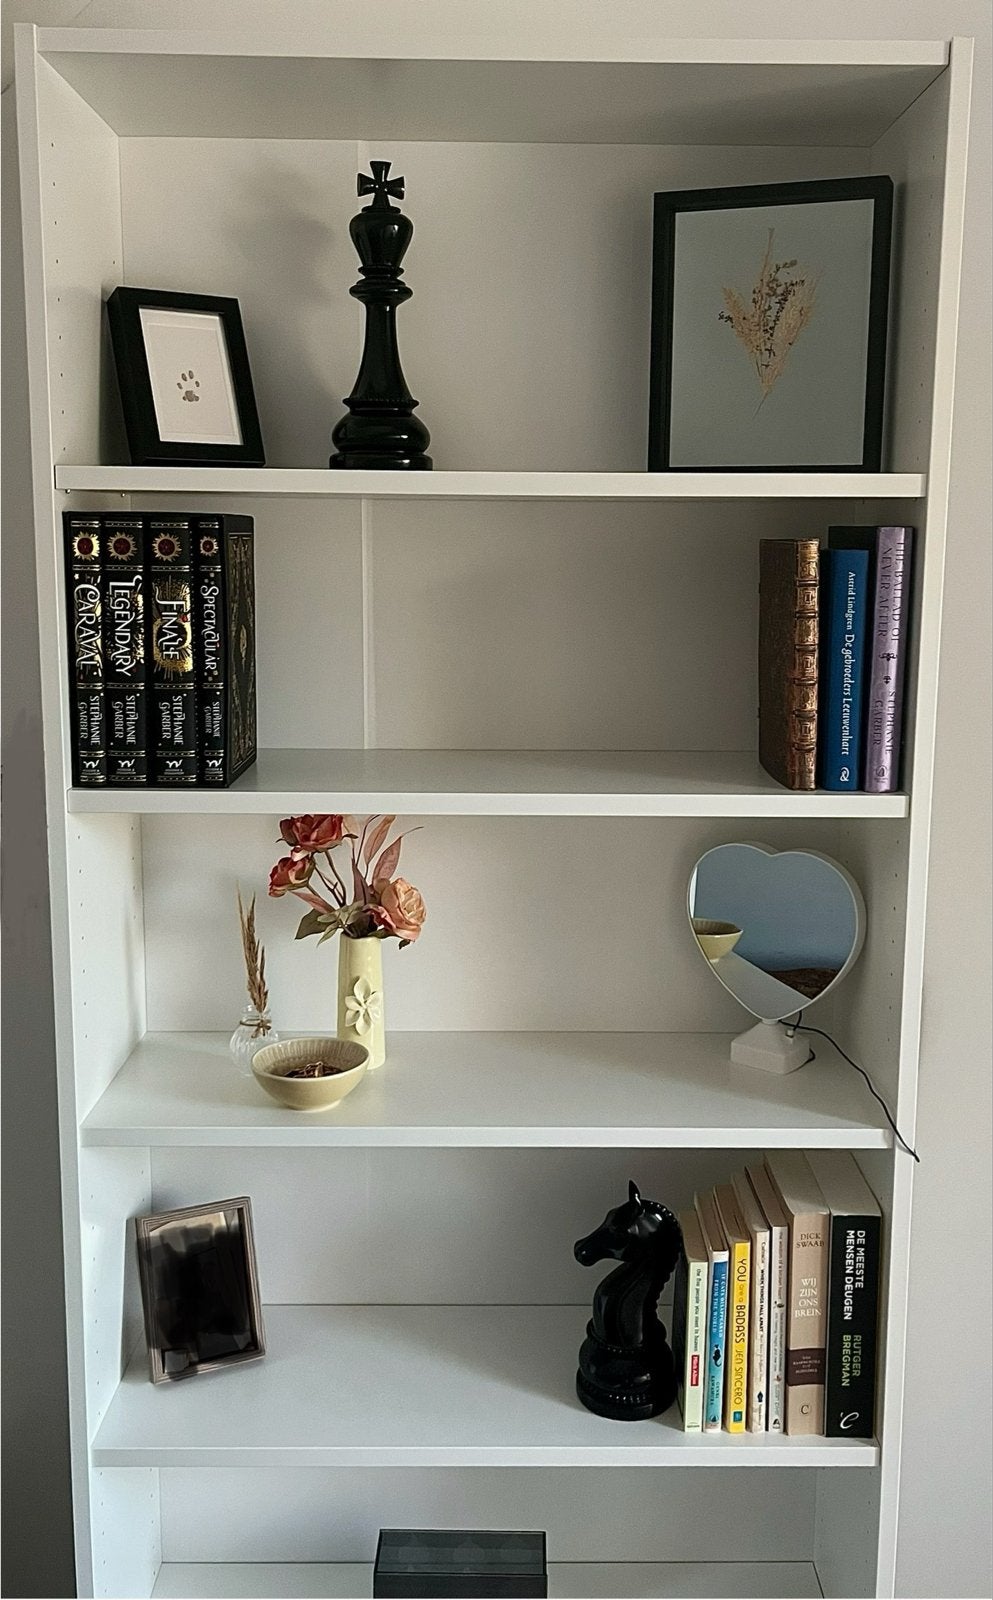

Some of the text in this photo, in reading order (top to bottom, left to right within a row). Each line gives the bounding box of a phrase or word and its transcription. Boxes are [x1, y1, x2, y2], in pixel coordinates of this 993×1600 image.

[895, 542, 905, 561] THE
[877, 548, 892, 637] NEVER AFTER
[892, 571, 904, 622] BALLAD
[74, 584, 102, 670] CARAVAL
[109, 575, 143, 676] LEGENDARY
[155, 586, 187, 660] FINALE
[200, 585, 220, 670] SPECTACULAR
[841, 571, 856, 755] Astrid Lindgren De gebroeders Leeuwenhart
[78, 702, 88, 739] GARBER
[89, 695, 103, 746] STEPHANIE
[112, 701, 124, 739] GARBER
[126, 695, 139, 745] STEPHANIE
[158, 702, 171, 739] GARBER
[172, 695, 186, 745] STEPHANIE
[204, 706, 212, 734] GARBER
[212, 701, 222, 738] STEPHANIE
[872, 700, 884, 746] GARBER
[884, 691, 896, 753] STEPHANIE
[737, 1259, 747, 1282] YOU
[843, 1230, 855, 1320] MENSEN DEUGEN
[855, 1230, 866, 1288] DE MEESTE
[799, 1299, 818, 1307] ONS
[800, 1288, 818, 1297] ZIJN
[801, 1278, 816, 1287] WIJ
[735, 1304, 746, 1344] BADASS
[795, 1309, 821, 1317] BREIN
[841, 1335, 851, 1387] BREGMAN
[852, 1335, 861, 1377] RUTGER
[734, 1366, 743, 1405] SINCERO
